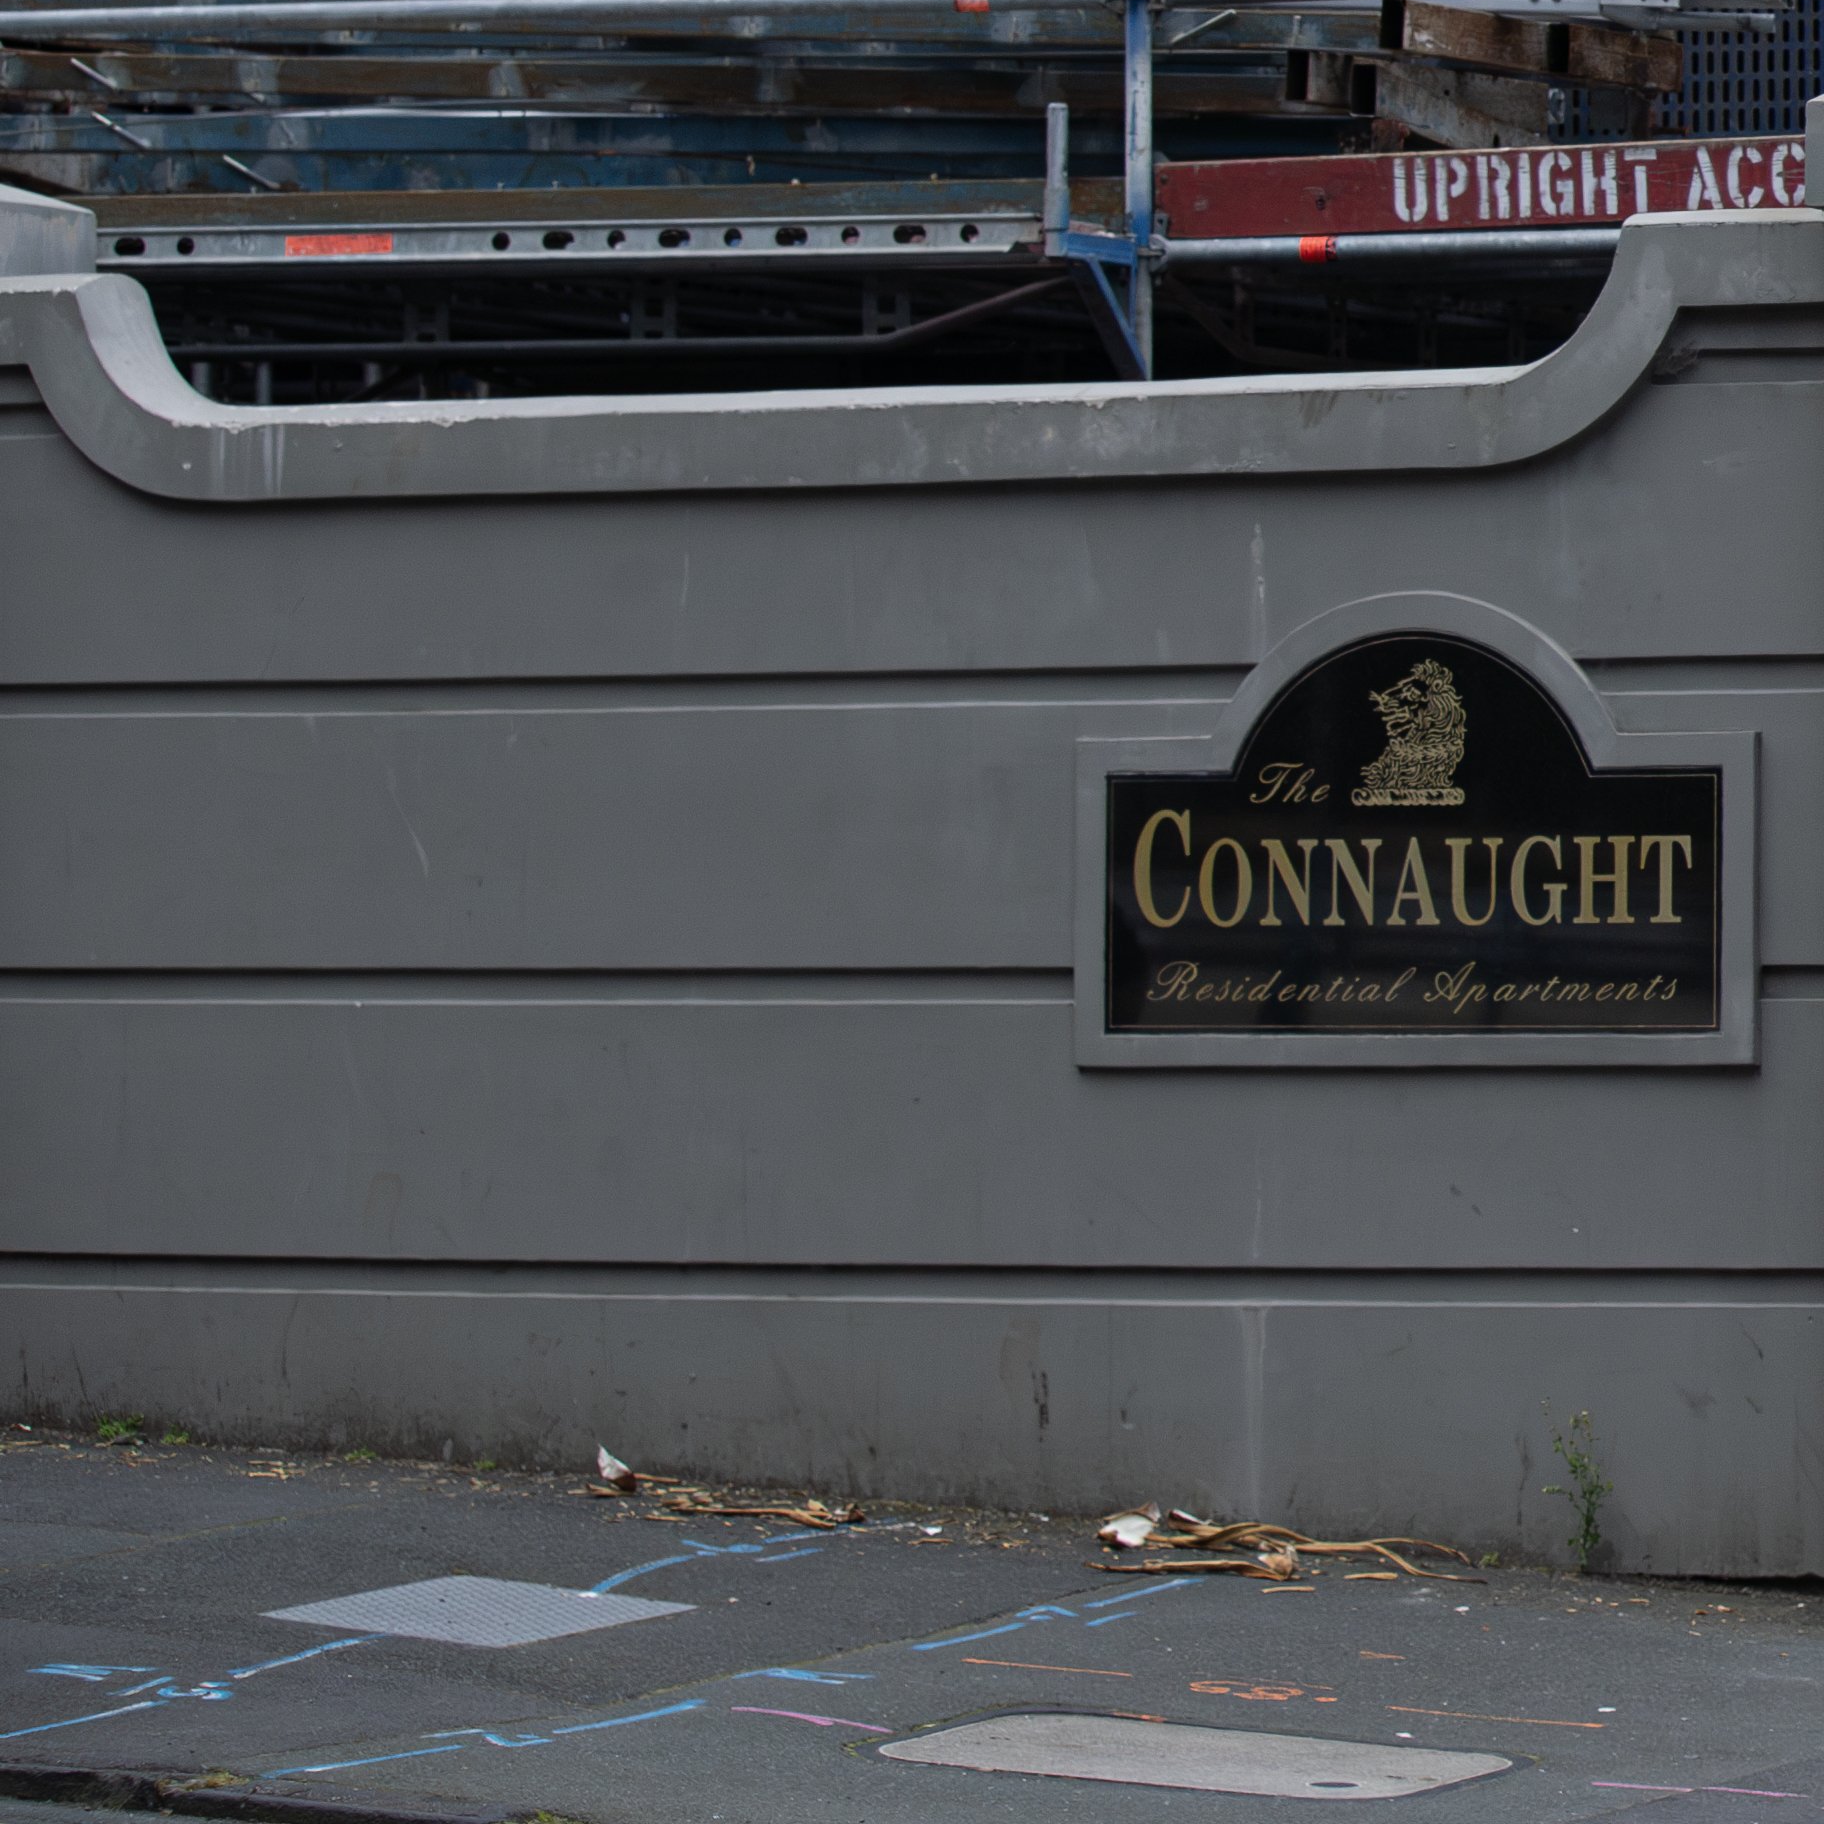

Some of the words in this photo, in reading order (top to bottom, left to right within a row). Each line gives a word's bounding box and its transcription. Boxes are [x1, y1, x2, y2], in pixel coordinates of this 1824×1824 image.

[1392, 147, 1657, 223] UPRIGHT
[1250, 762, 1330, 804] The
[1145, 960, 1404, 1003] Residential
[1422, 960, 1679, 1014] Apartments
